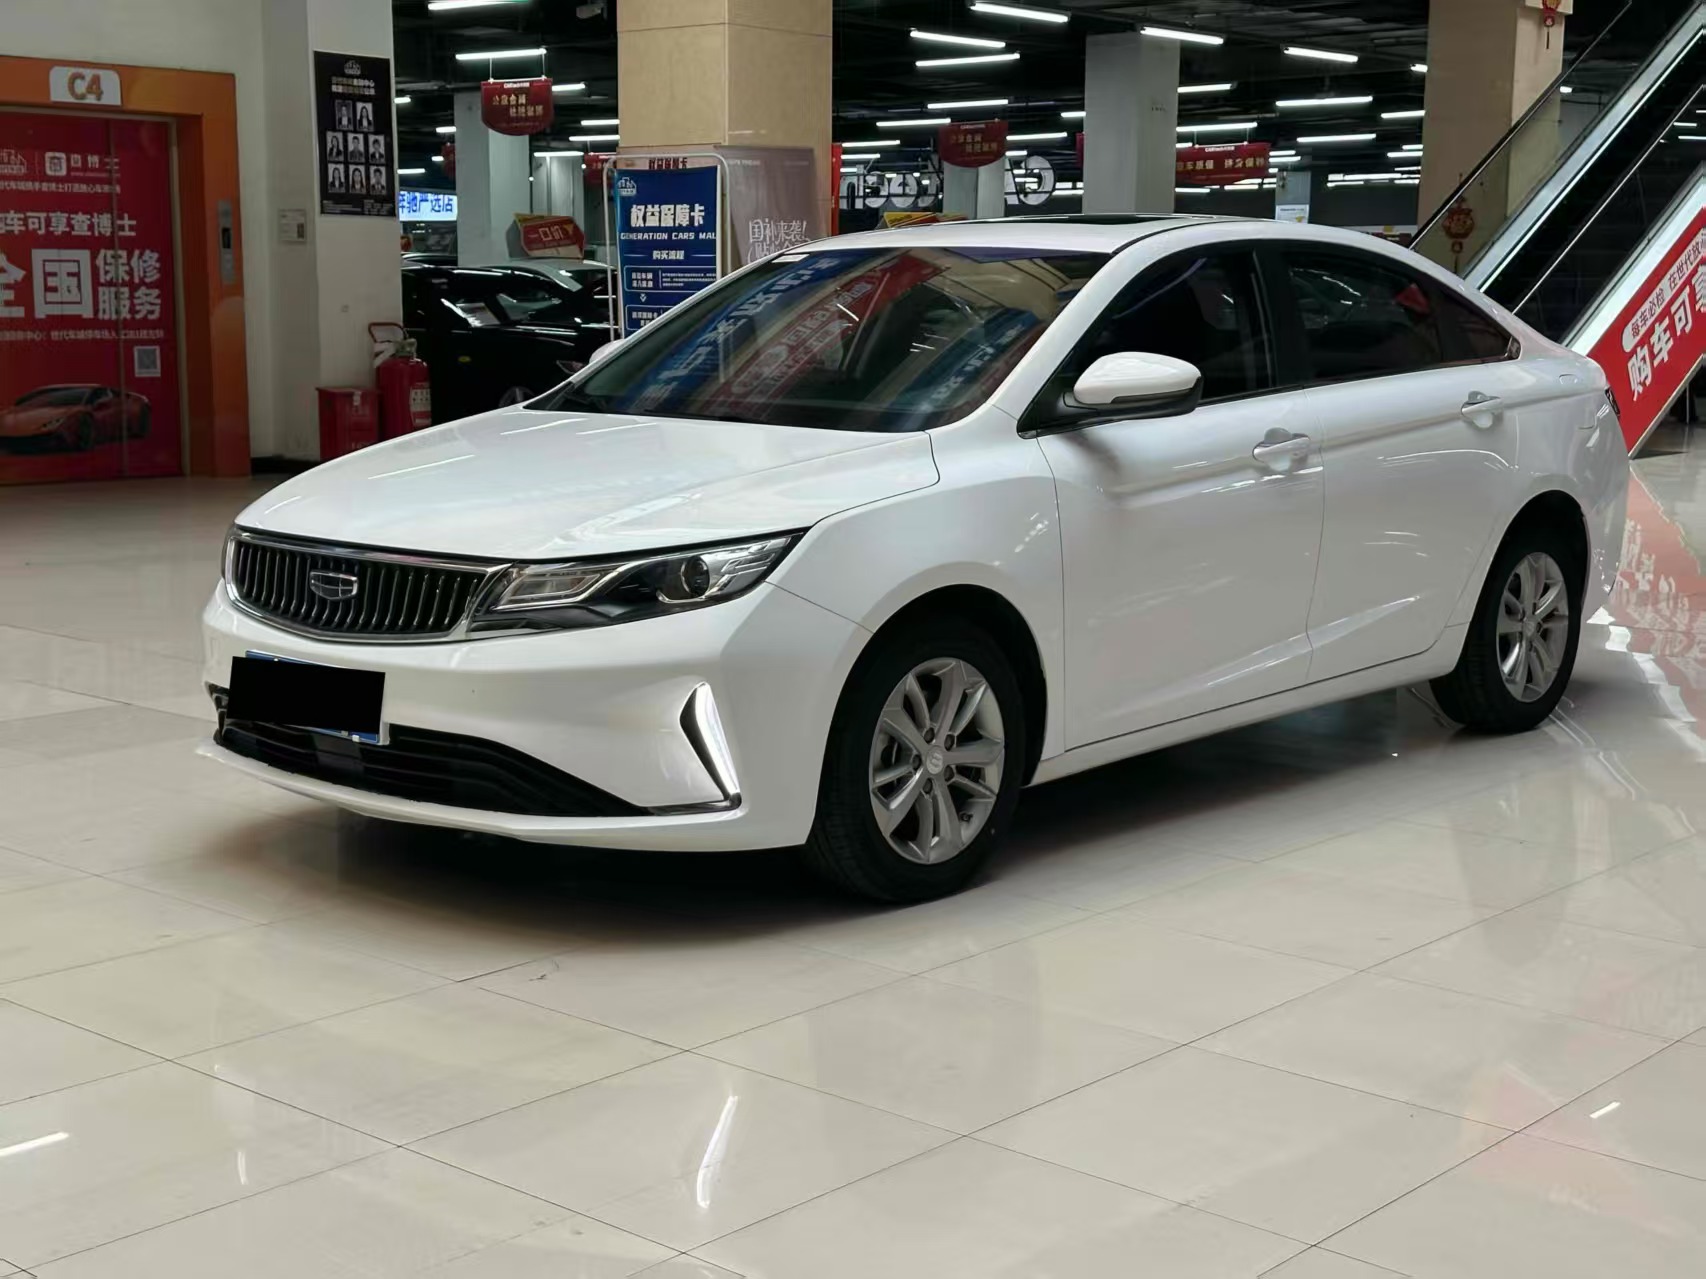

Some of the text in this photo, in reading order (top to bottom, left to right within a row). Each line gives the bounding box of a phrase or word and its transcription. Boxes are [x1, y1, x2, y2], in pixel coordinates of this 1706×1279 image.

[68, 72, 104, 101] C4
[630, 204, 705, 228] 权益保障卡
[527, 225, 564, 241] 一口价
[620, 232, 668, 241] GENERATION
[672, 232, 695, 240] CARS
[95, 249, 161, 284] 保修
[97, 286, 162, 320] 服务
[1631, 288, 1665, 338] 每车必检
